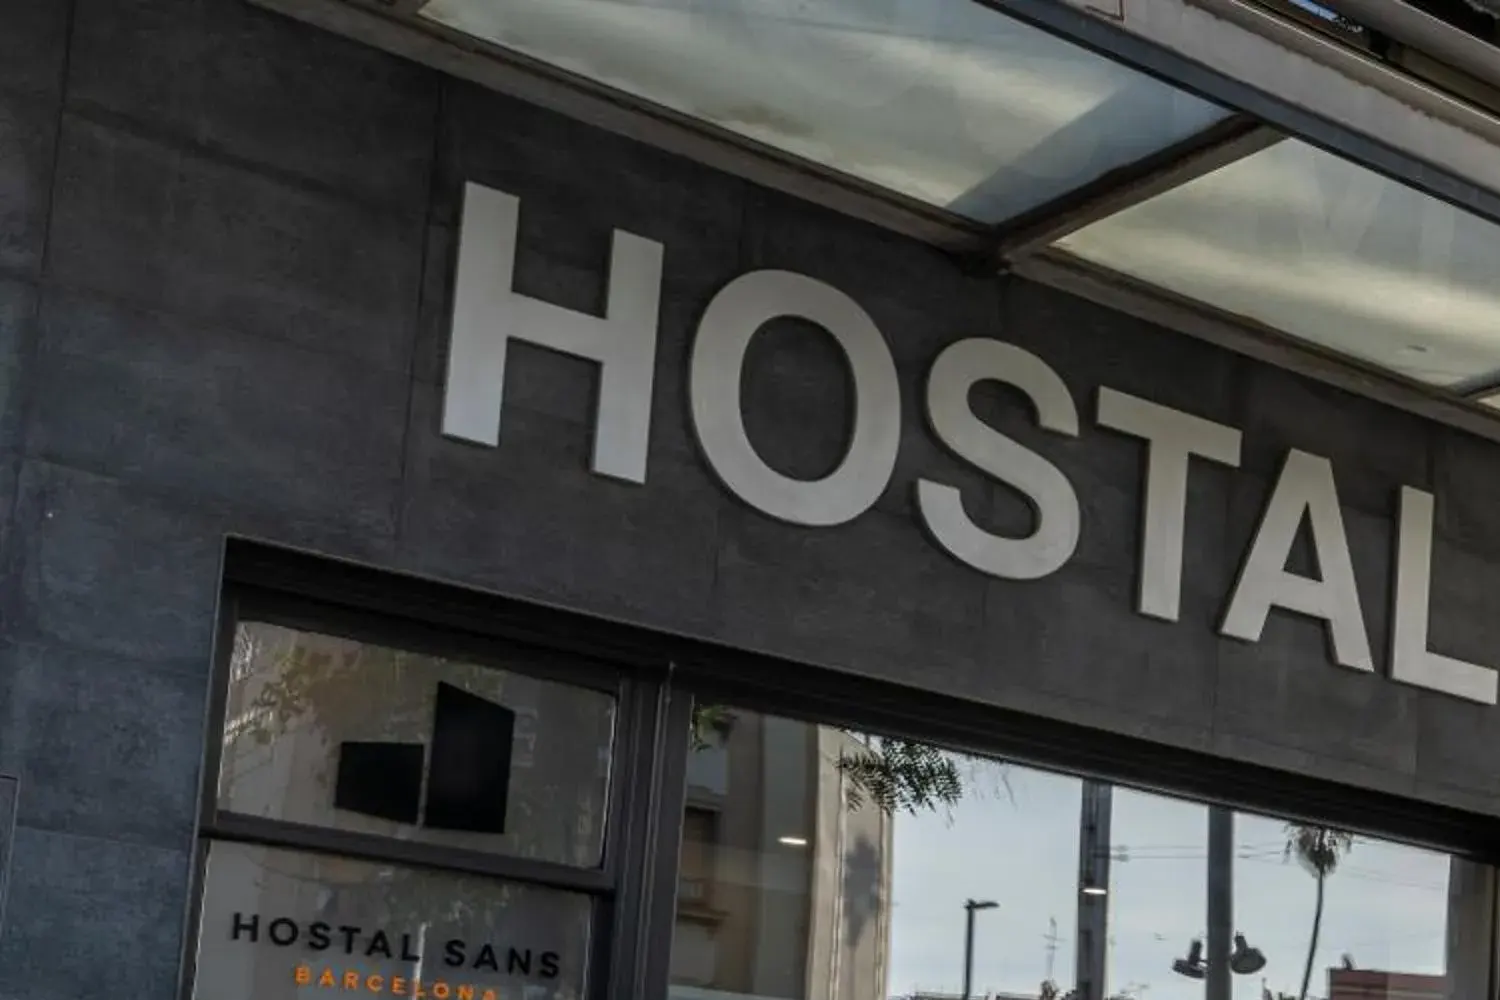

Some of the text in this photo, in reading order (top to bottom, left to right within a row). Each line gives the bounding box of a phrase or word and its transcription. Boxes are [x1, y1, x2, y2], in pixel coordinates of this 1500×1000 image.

[440, 180, 1499, 707] HOSTAL
[231, 912, 561, 980] HOSTAL SANS
